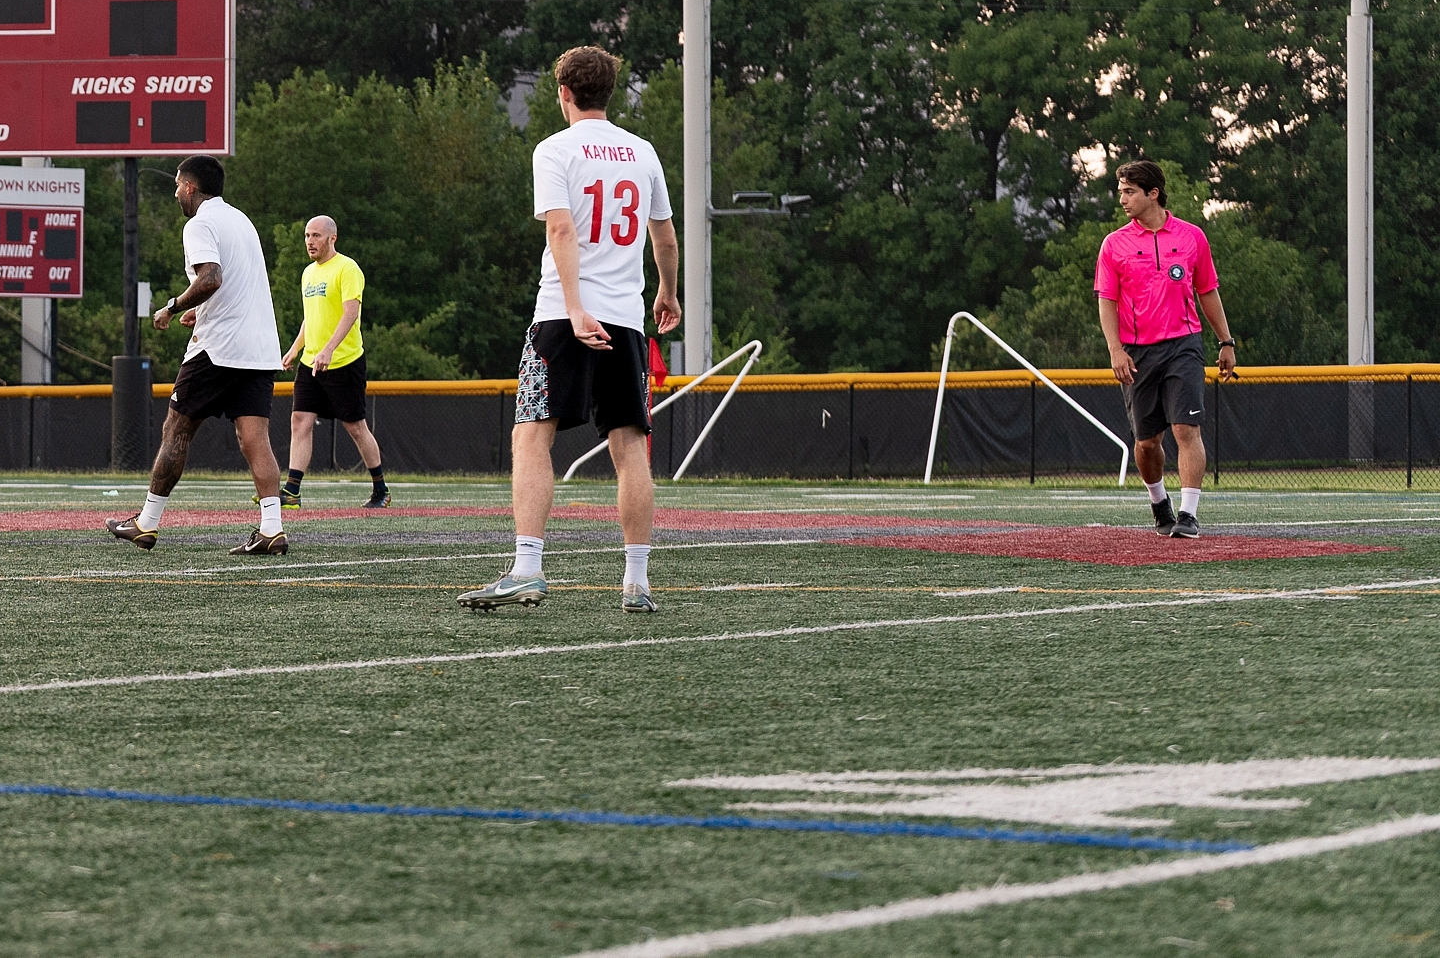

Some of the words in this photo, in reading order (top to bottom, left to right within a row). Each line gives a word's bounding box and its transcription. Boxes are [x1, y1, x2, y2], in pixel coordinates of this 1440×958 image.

[70, 76, 136, 95] KICKS
[144, 75, 214, 94] SHOTS
[581, 144, 636, 163] KAYNER
[27, 180, 81, 194] KNIGHTS
[44, 213, 78, 227] HOME
[583, 178, 640, 248] 13
[29, 231, 38, 245] E
[48, 266, 72, 281] OUT
